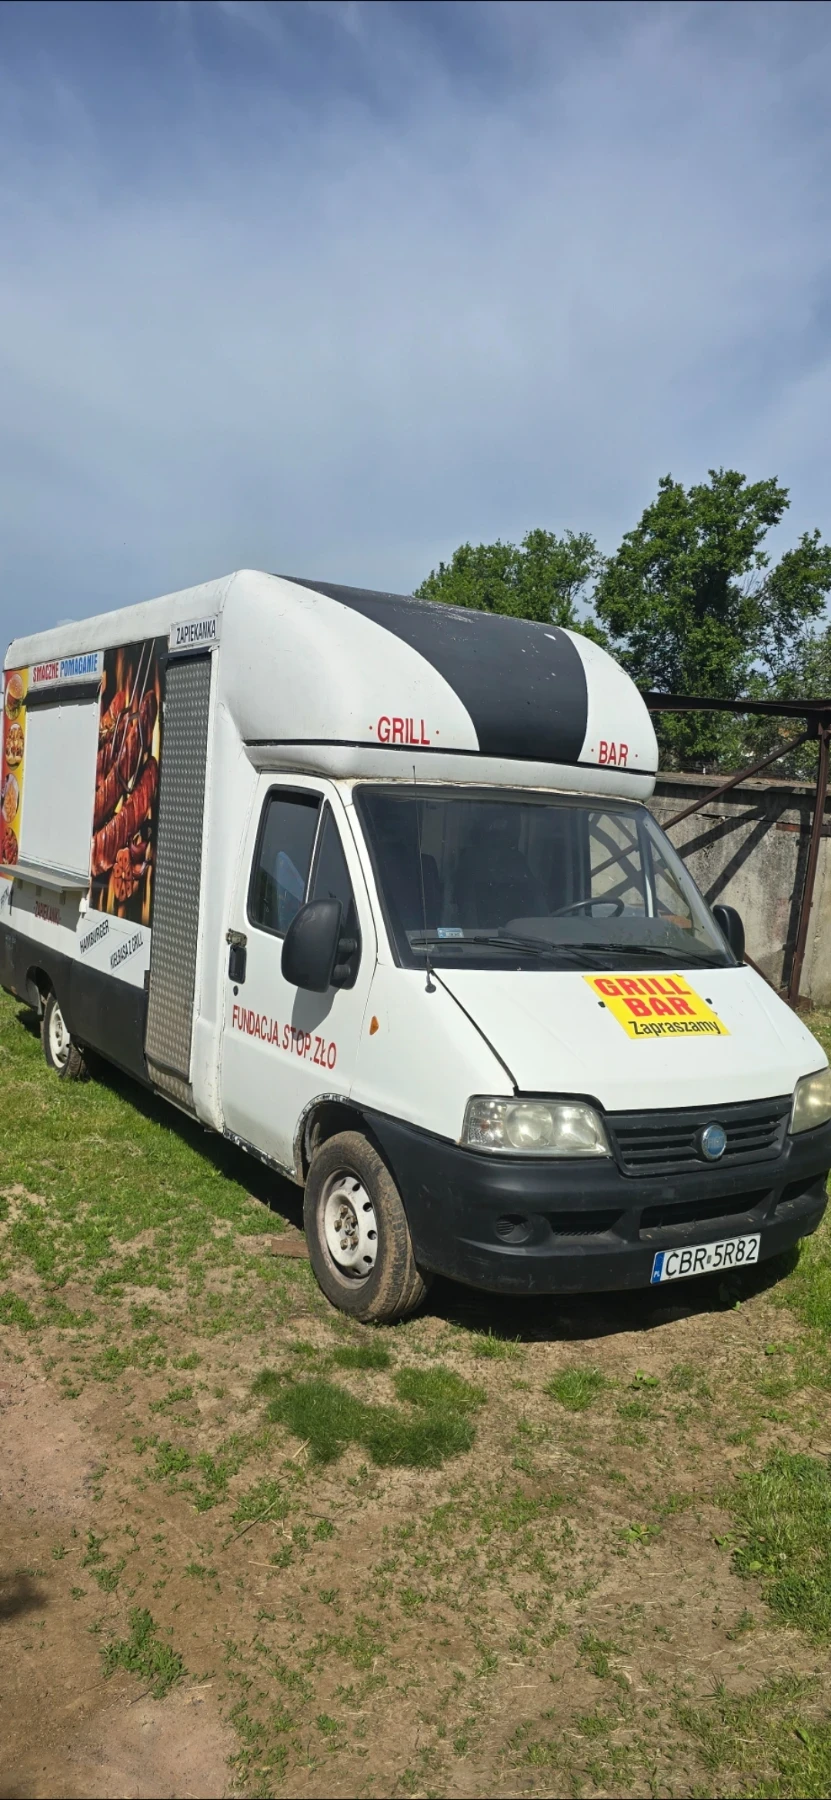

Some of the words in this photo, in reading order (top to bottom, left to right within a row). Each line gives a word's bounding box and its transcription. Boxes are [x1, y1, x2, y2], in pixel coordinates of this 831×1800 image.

[176, 619, 216, 645] ZAPIEKANKA
[33, 661, 59, 682] SMACZNE
[60, 653, 98, 677] POMAGANIE
[377, 716, 430, 745] GRILL
[599, 741, 628, 766] BAR
[80, 919, 110, 954] HAMBURGER
[594, 978, 692, 996] GRILL
[622, 997, 697, 1016] BAR
[628, 1021, 721, 1036] Zapraszamy
